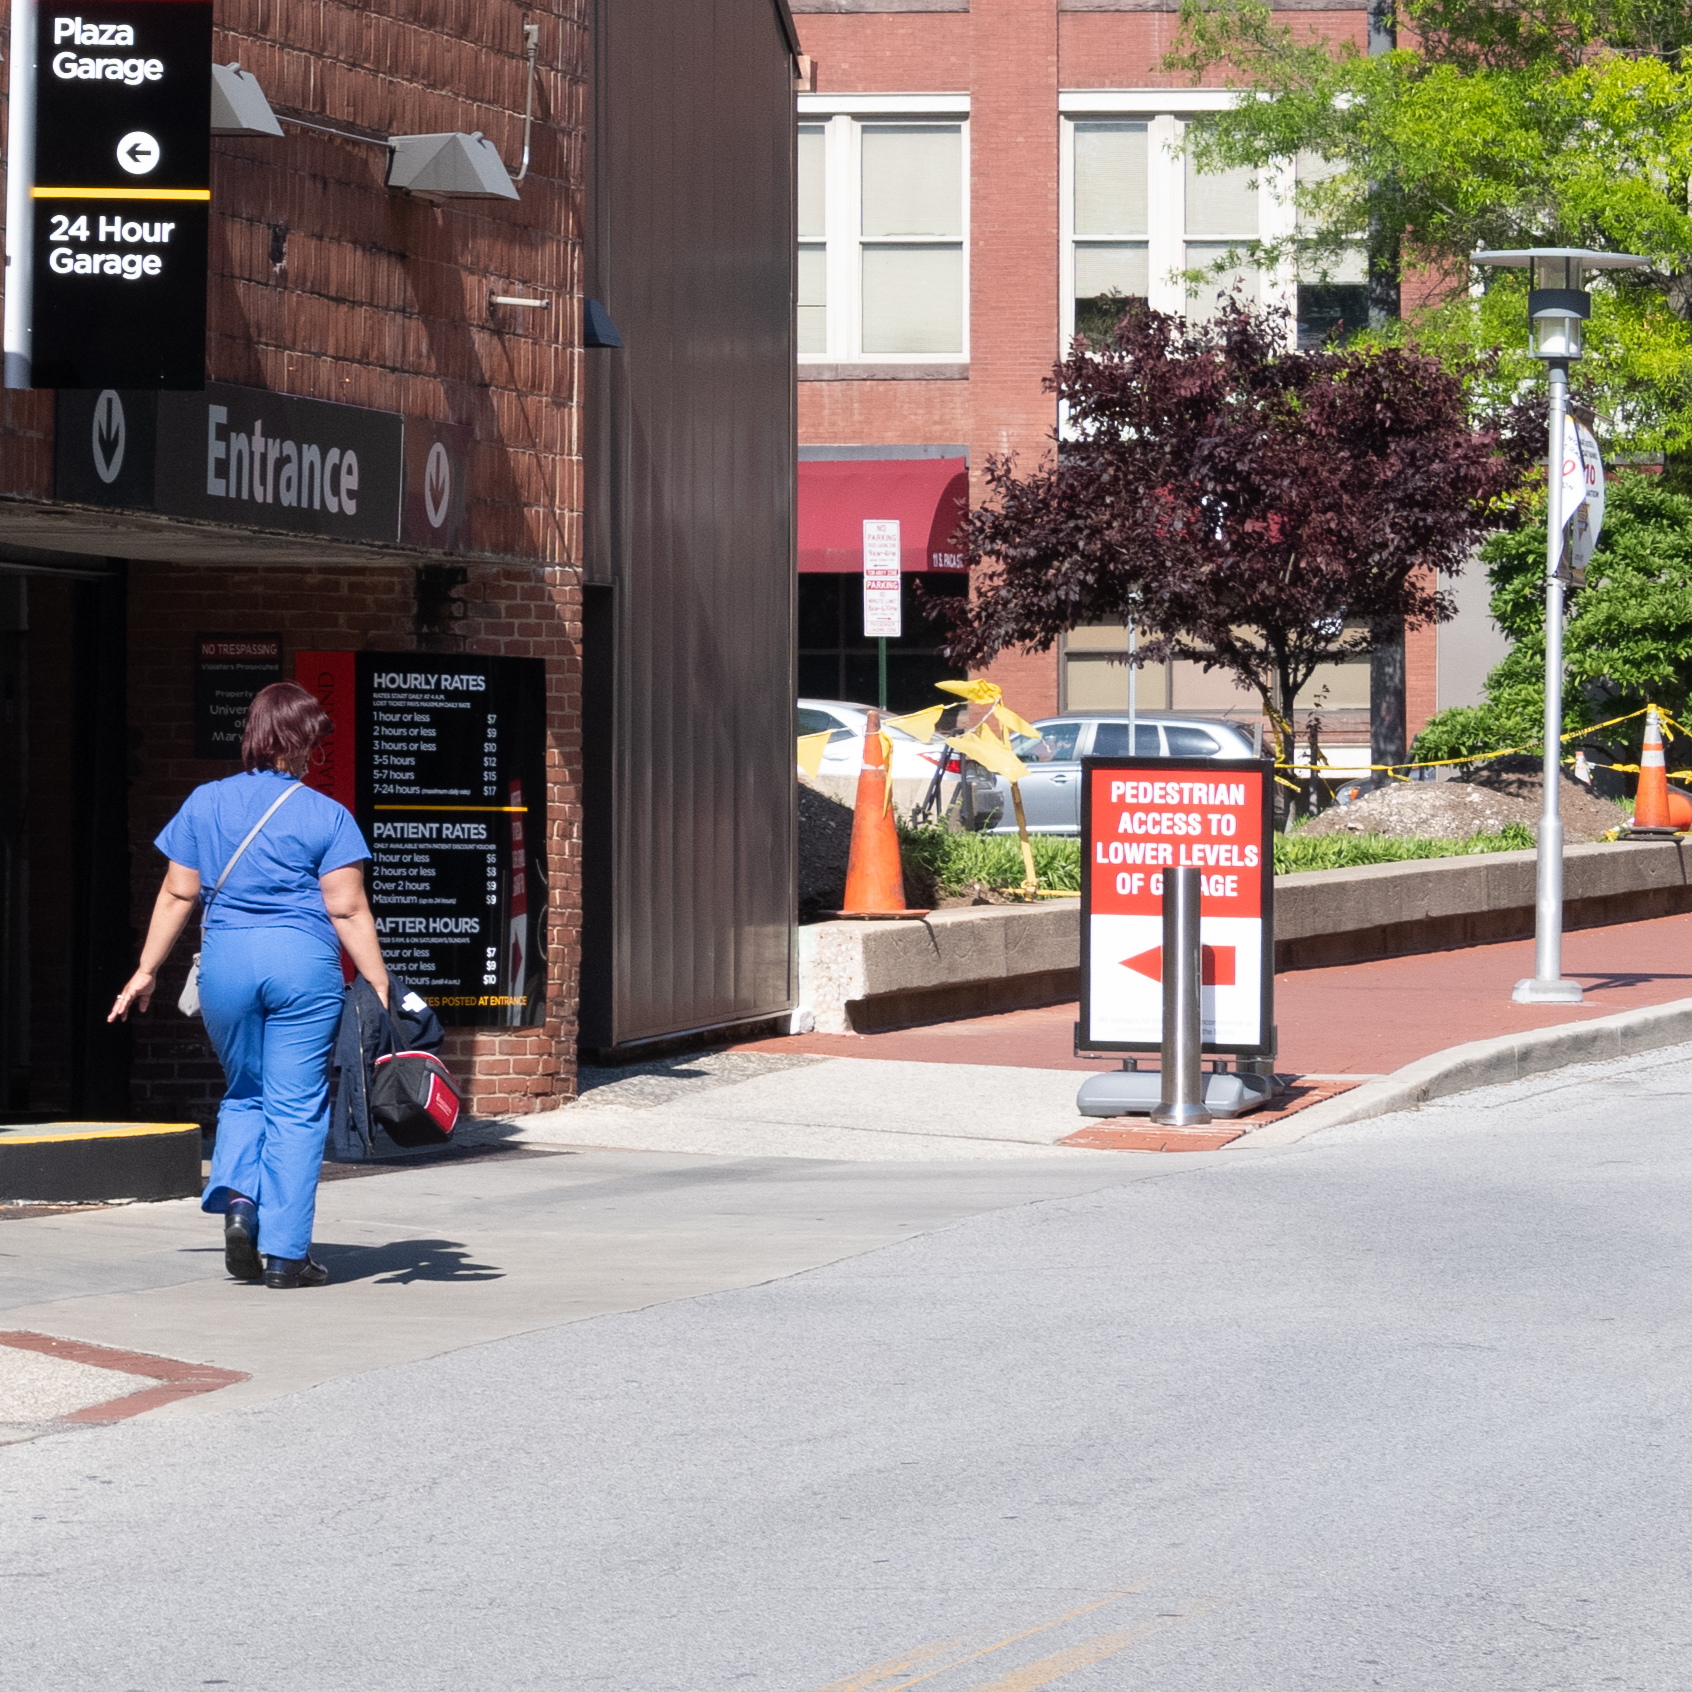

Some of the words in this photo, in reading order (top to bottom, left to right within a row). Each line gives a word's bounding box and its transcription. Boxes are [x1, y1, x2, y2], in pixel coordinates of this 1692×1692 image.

[54, 17, 134, 46] Plaza
[53, 52, 164, 85] Garage
[50, 215, 90, 242] 24
[99, 216, 175, 243] Hour
[49, 248, 163, 279] Garage
[206, 404, 359, 515] Entrance
[877, 524, 886, 532] NO
[867, 581, 898, 589] PARKING
[201, 644, 215, 655] NO
[217, 644, 278, 655] TRESPASSING
[236, 663, 279, 671] Prosecuted
[373, 672, 438, 690] HOURLY
[440, 674, 486, 691] RATES
[215, 690, 254, 699] Property
[209, 704, 249, 716] Univer
[373, 711, 377, 721] 1
[379, 711, 401, 722] hour
[402, 711, 412, 722] or
[414, 711, 430, 722] less
[486, 714, 497, 724] $7
[373, 726, 380, 736] 2
[381, 726, 407, 736] hours
[408, 726, 419, 736] or
[420, 726, 437, 736] less
[486, 728, 497, 738] $9
[211, 731, 244, 743] Mary
[373, 740, 379, 750] 3
[381, 740, 407, 751] hours
[408, 740, 419, 751] or
[420, 740, 437, 751] less
[483, 742, 497, 753] $10
[373, 755, 388, 765] 3-5
[390, 755, 415, 765] hours
[483, 757, 497, 767] $12
[373, 769, 388, 779] 5-7
[390, 769, 415, 780] hours
[483, 771, 497, 782] $15
[373, 784, 394, 794] 7-24
[396, 785, 420, 795] hours
[483, 786, 497, 796] $17
[1111, 781, 1245, 805] PEDESTRIAN
[1118, 812, 1201, 835] ACCESS
[1207, 814, 1237, 836] TO
[373, 822, 440, 839] PATIENT
[442, 823, 487, 839] RATES
[373, 853, 377, 862] 1
[379, 853, 401, 863] hour
[402, 853, 412, 863] or
[413, 853, 430, 863] less
[486, 853, 497, 864] $6
[1096, 842, 1172, 865] LOWER
[1179, 844, 1259, 867] LEVELS
[373, 866, 379, 876] 2
[381, 866, 407, 876] hours
[408, 866, 418, 876] or
[420, 866, 436, 876] less
[486, 866, 497, 877] $8
[373, 880, 396, 890] Over
[397, 880, 404, 890] 2
[405, 880, 430, 890] hours
[486, 880, 497, 891] $9
[1116, 872, 1145, 895] OF
[1150, 873, 1238, 897] GAGE
[373, 894, 417, 904] Maximum
[485, 894, 497, 905] $9
[375, 917, 426, 933] AFTER
[429, 918, 480, 934] HOURS
[401, 950, 412, 958] or
[413, 947, 430, 958] less
[486, 947, 497, 958] $7
[408, 963, 418, 971] or
[420, 961, 436, 971] less
[486, 960, 497, 971] $9
[405, 975, 430, 985] hours
[483, 974, 497, 985] $10
[423, 997, 440, 1007] TES
[442, 996, 477, 1007] POSTED
[478, 996, 489, 1006] AT
[490, 996, 527, 1006] ENTRANCE
